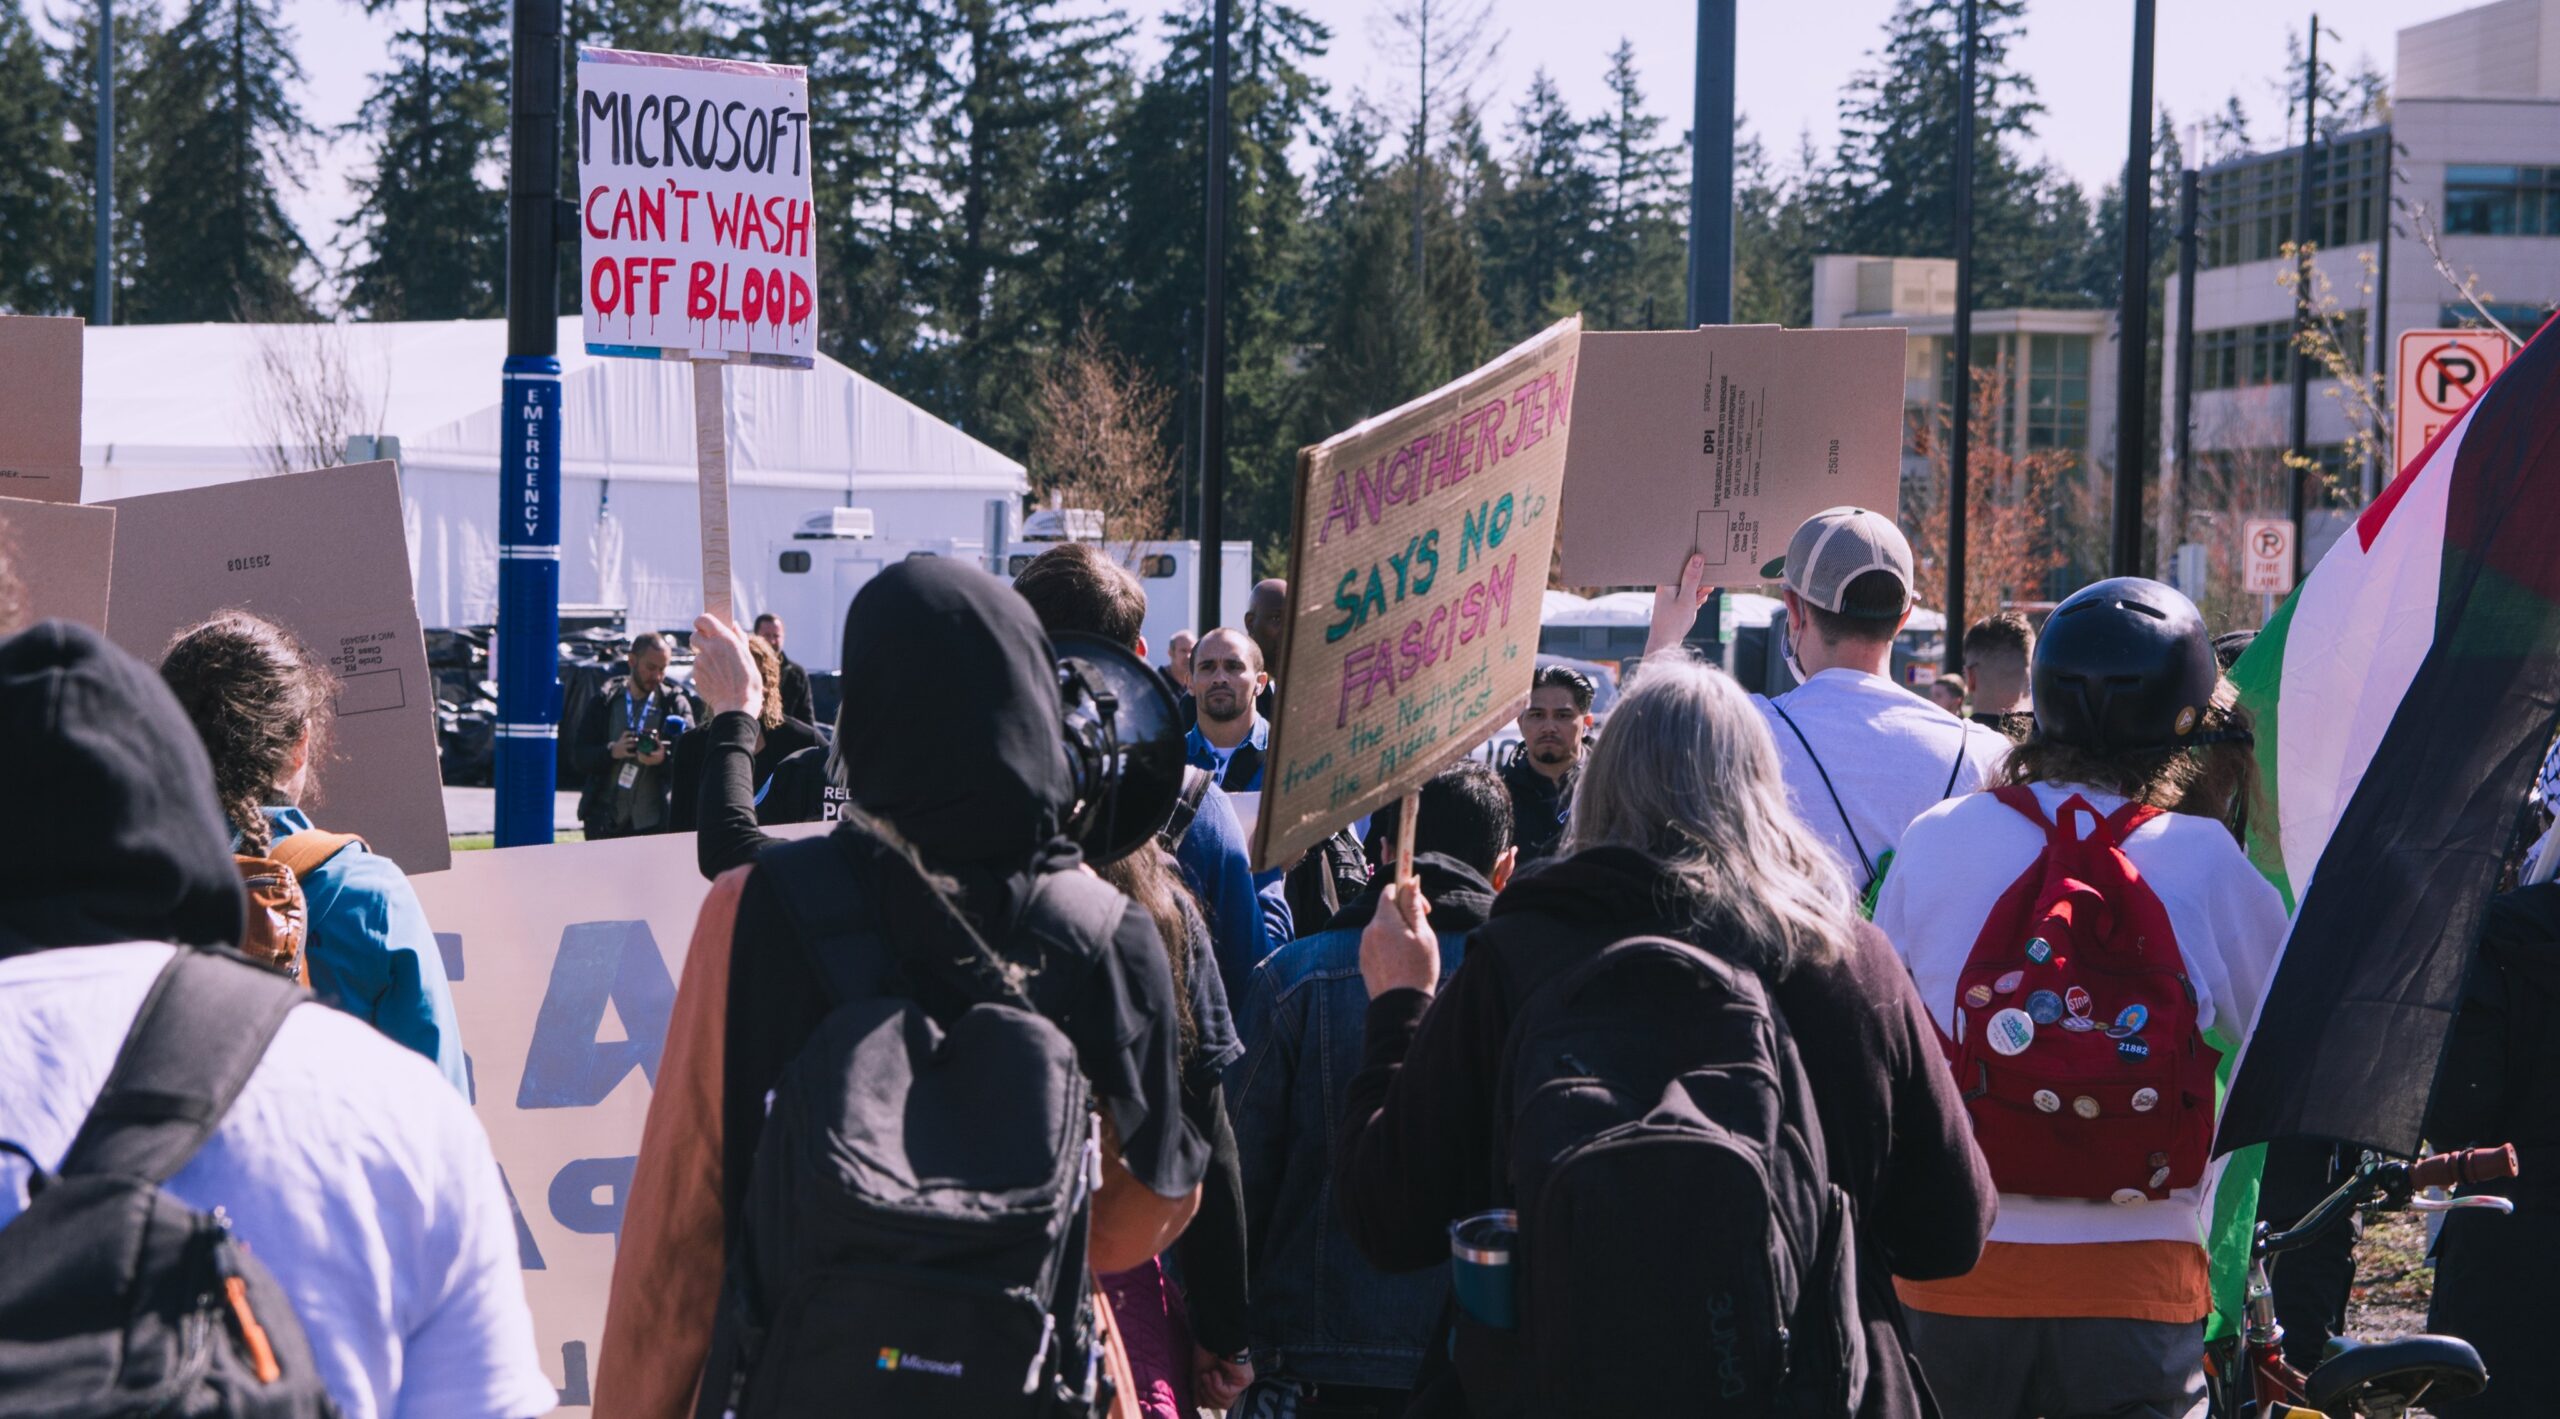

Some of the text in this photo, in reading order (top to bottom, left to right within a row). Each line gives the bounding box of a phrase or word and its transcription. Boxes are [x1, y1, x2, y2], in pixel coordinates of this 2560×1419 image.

[582, 89, 808, 177] MICROSOFT
[585, 178, 811, 257] CAN'T WASH
[590, 256, 814, 342] OFF BLOOD
[1719, 375, 1727, 413] WAREHOUSE
[1728, 384, 1737, 425] APPROPRIATE
[1703, 429, 1715, 454] DPI
[1717, 422, 1725, 447] RETURN
[1727, 426, 1735, 443] WHEN
[523, 388, 544, 537] EMERGENCY
[1318, 355, 1576, 546] ANOTHER JEW
[1715, 462, 1723, 491] SECURELY
[1725, 444, 1734, 486] DESTRUCTION
[1731, 521, 1738, 532] RX
[1325, 482, 1546, 645] SAYS NO to
[2255, 562, 2280, 575] FIRE
[2253, 576, 2281, 588] LANE
[378, 631, 396, 641] WIC
[1336, 553, 1517, 730] FASCISM
[331, 655, 356, 666] C3-C5
[343, 647, 354, 655] C2
[358, 646, 381, 654] Class
[358, 656, 383, 666] Circle
[345, 664, 357, 672] RX
[1282, 636, 1518, 796] from the Northwest to
[1329, 774, 1360, 810] the
[1377, 724, 1438, 783] Middle
[1448, 678, 1493, 737] East
[2069, 995, 2089, 1011] STOP
[2118, 1042, 2149, 1056] 21882
[900, 1353, 963, 1378] Microsoft
